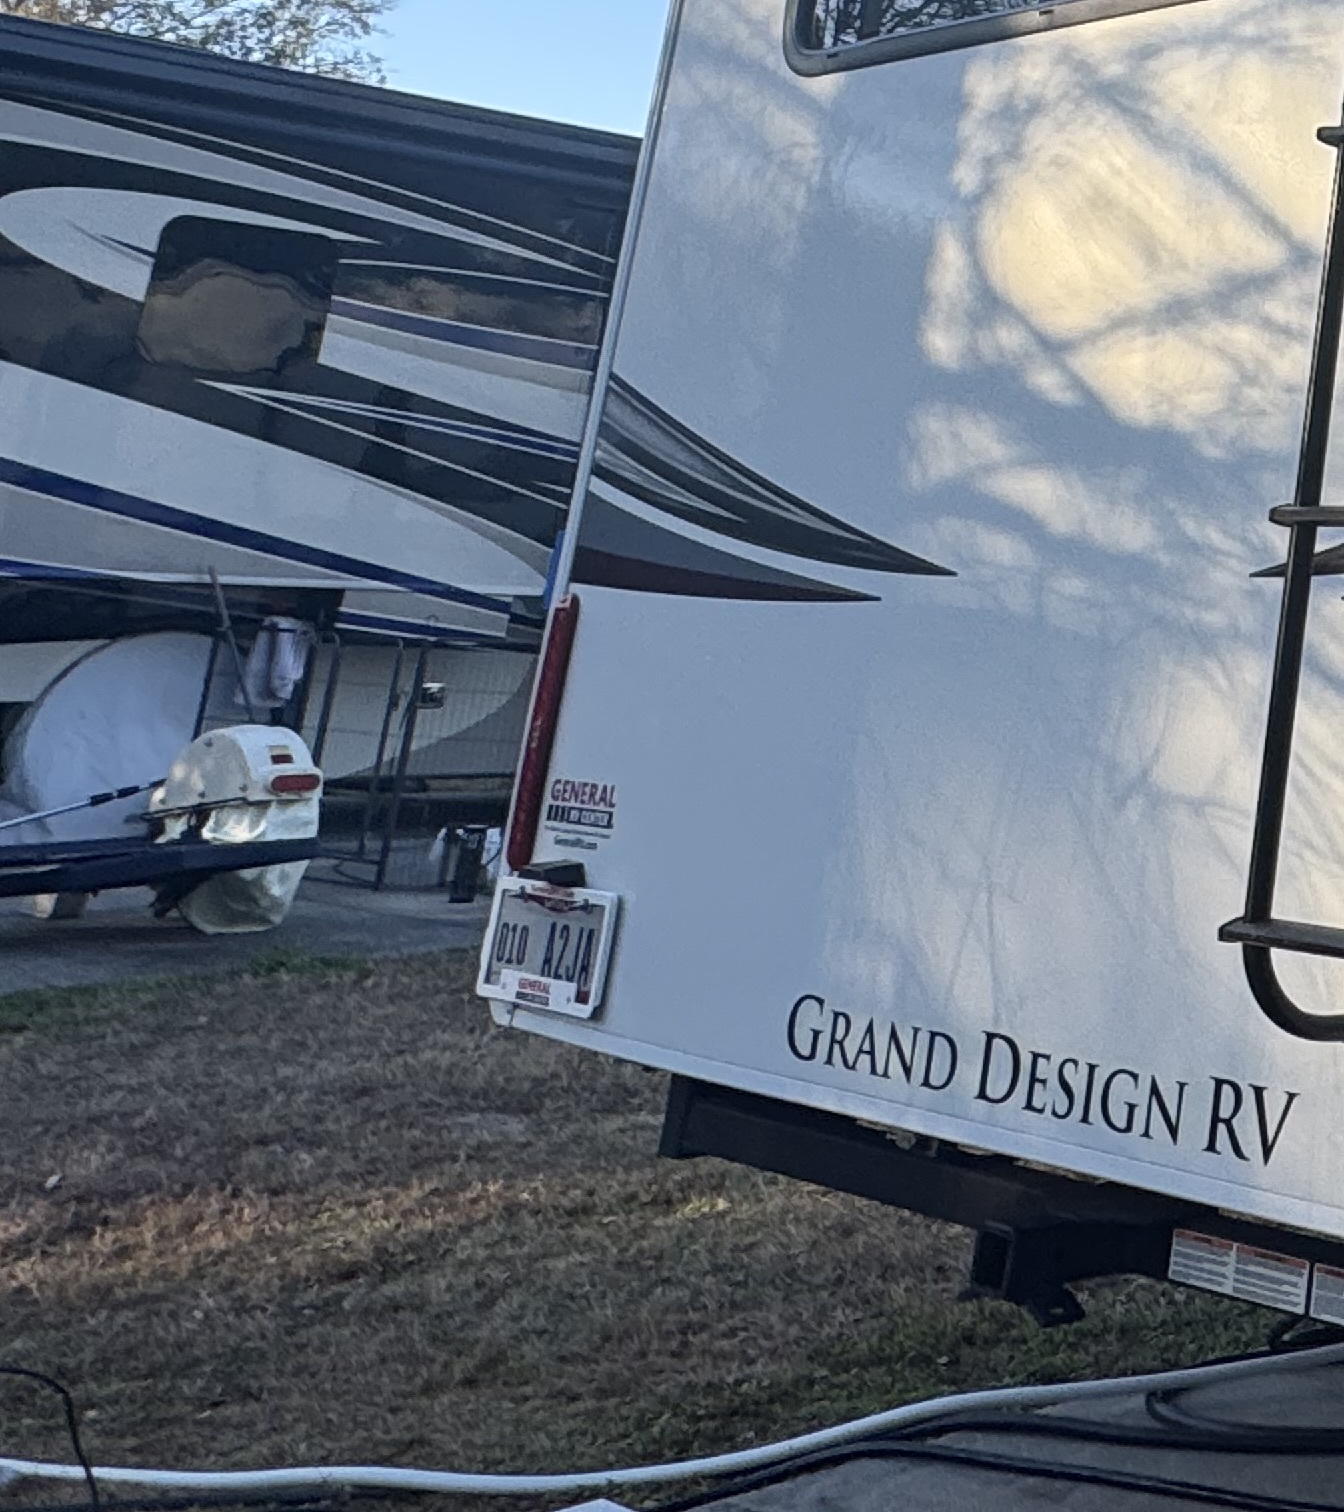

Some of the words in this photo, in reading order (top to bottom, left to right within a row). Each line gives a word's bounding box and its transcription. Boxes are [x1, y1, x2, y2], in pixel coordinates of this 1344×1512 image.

[550, 778, 616, 808] GENERAL
[786, 993, 959, 1091] GRAND
[973, 1030, 1190, 1146] DESIGN
[1202, 1076, 1300, 1167] RV
